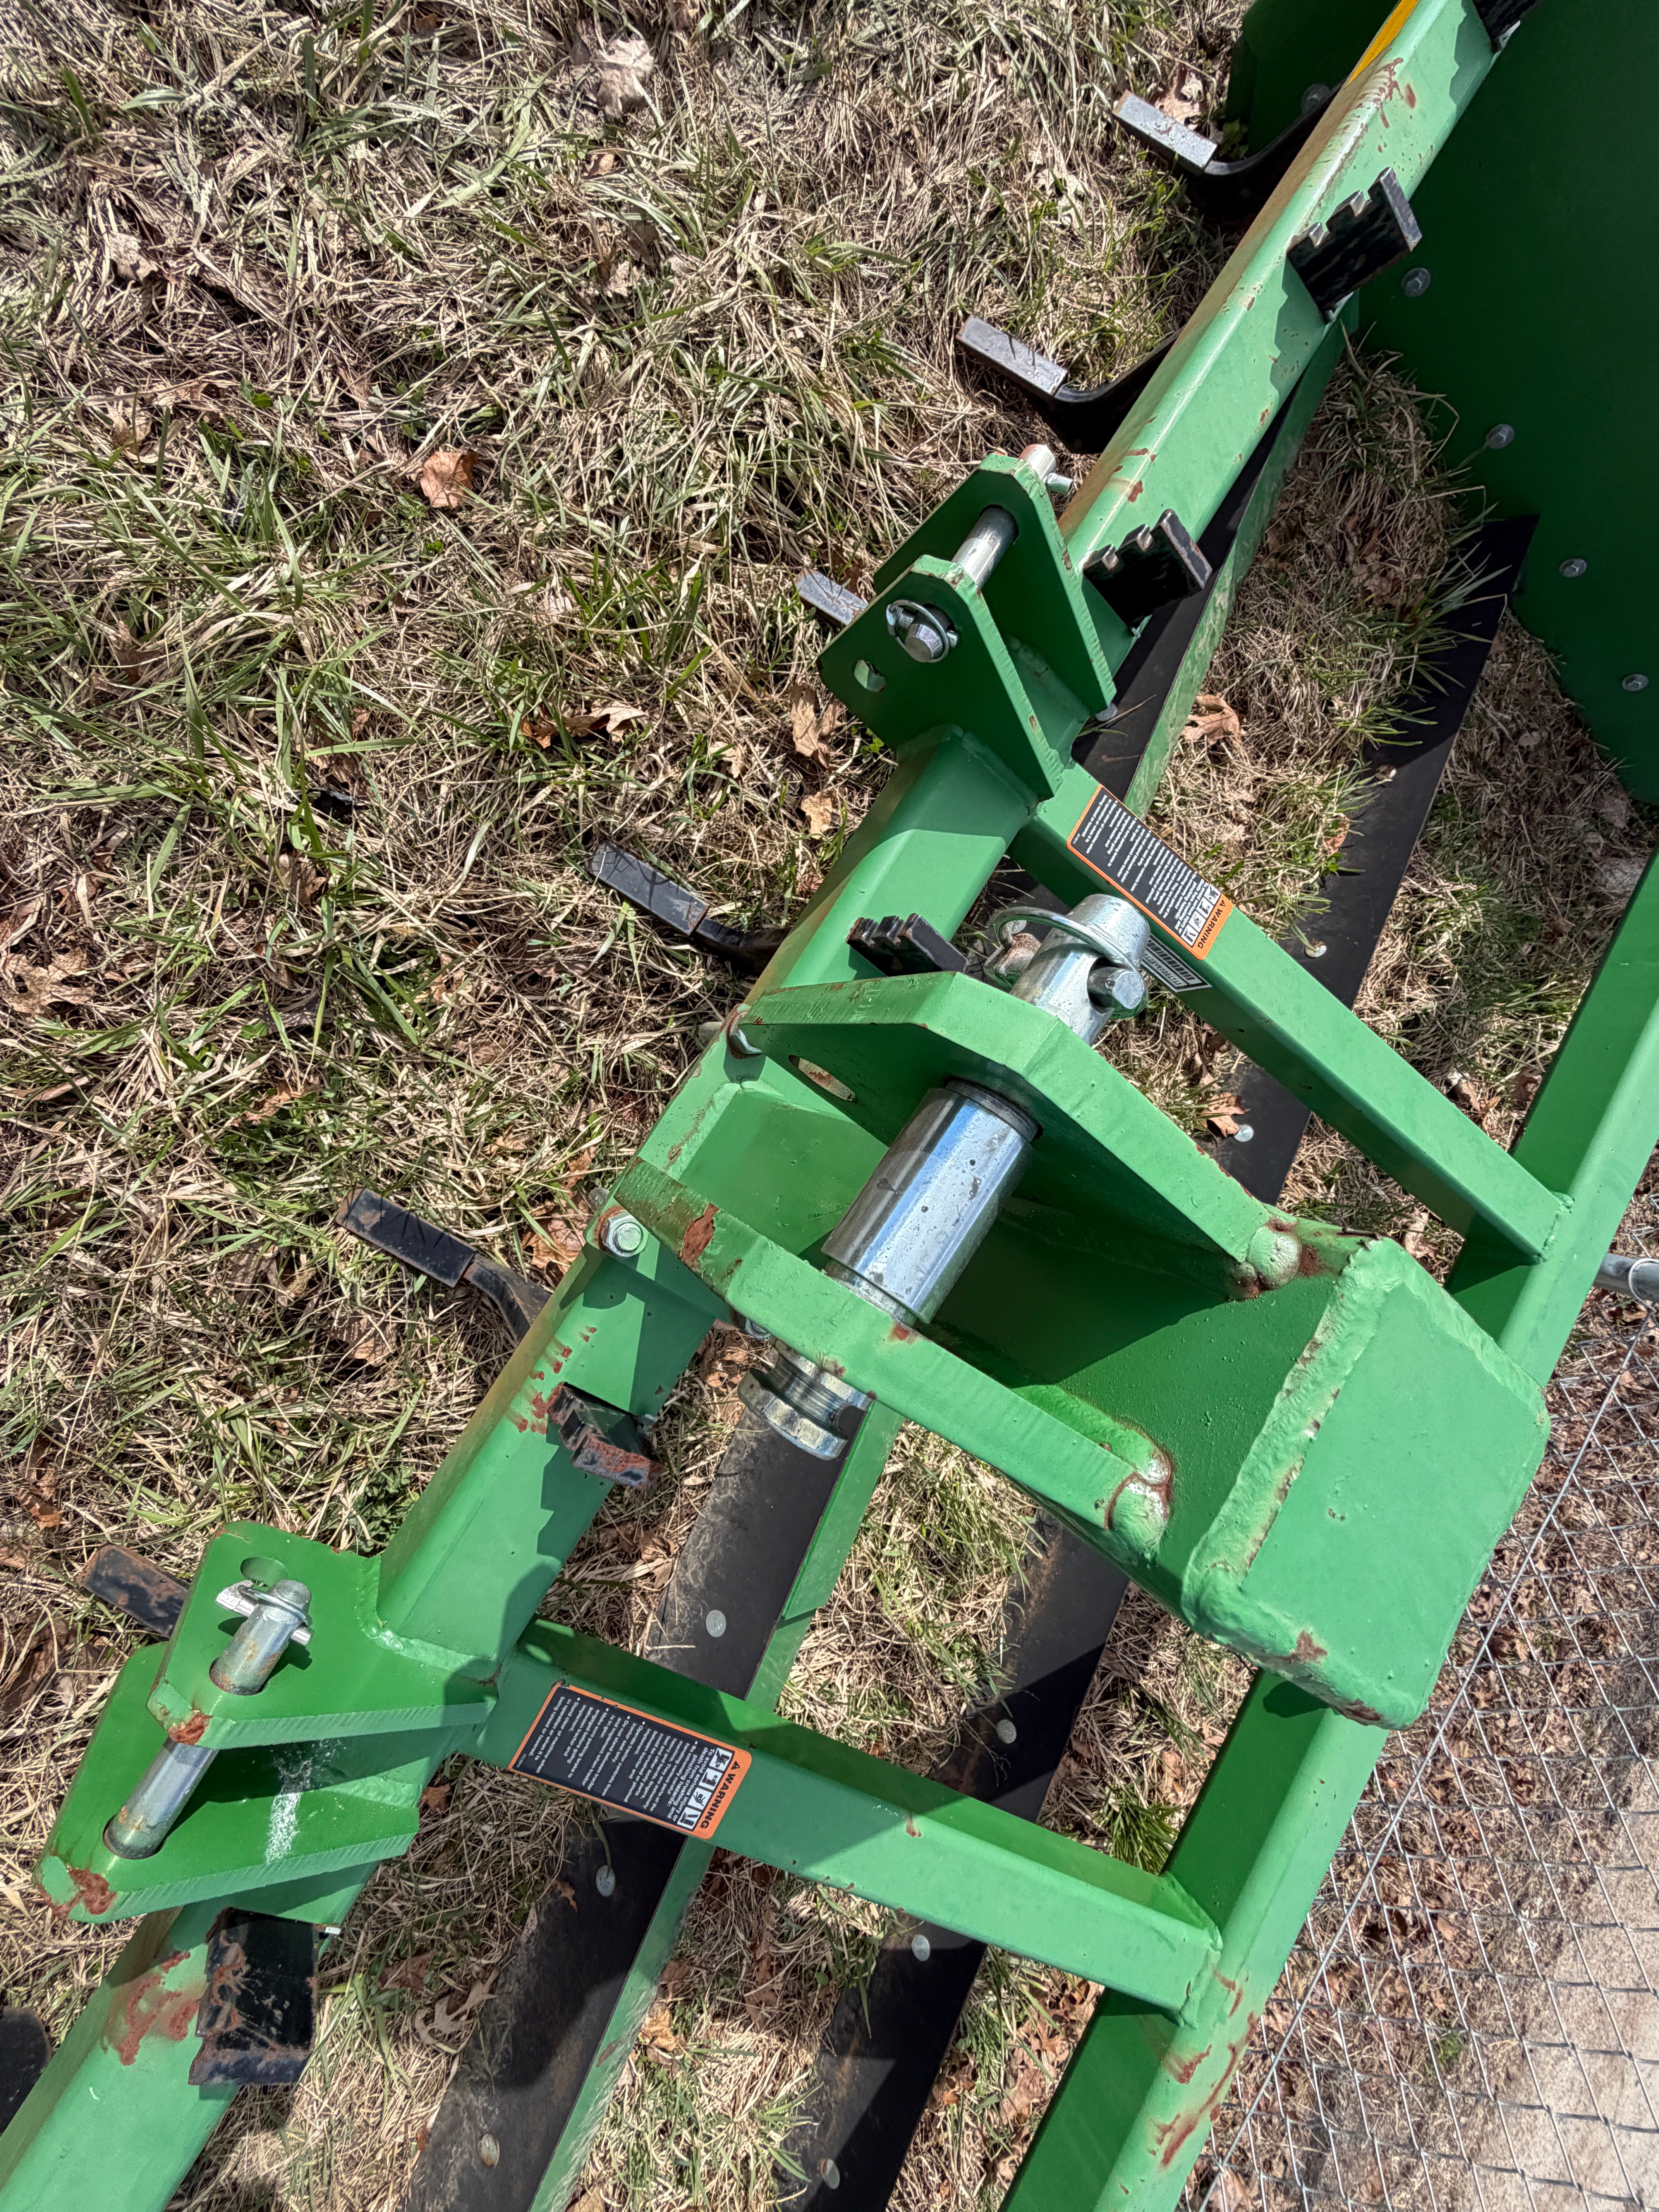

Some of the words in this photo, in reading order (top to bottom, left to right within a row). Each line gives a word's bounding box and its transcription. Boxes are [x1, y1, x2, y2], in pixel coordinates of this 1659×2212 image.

[1197, 908, 1223, 949] WARNING
[680, 1754, 697, 1781] pinching
[697, 1747, 708, 1764] death
[699, 1756, 710, 1774] avoid
[689, 1765, 700, 1779] from
[666, 1781, 684, 1807] hazards:
[673, 1779, 690, 1806] crushing
[686, 1774, 700, 1796] serious
[676, 1796, 689, 1814] injury
[700, 1773, 736, 1829] WARNING
